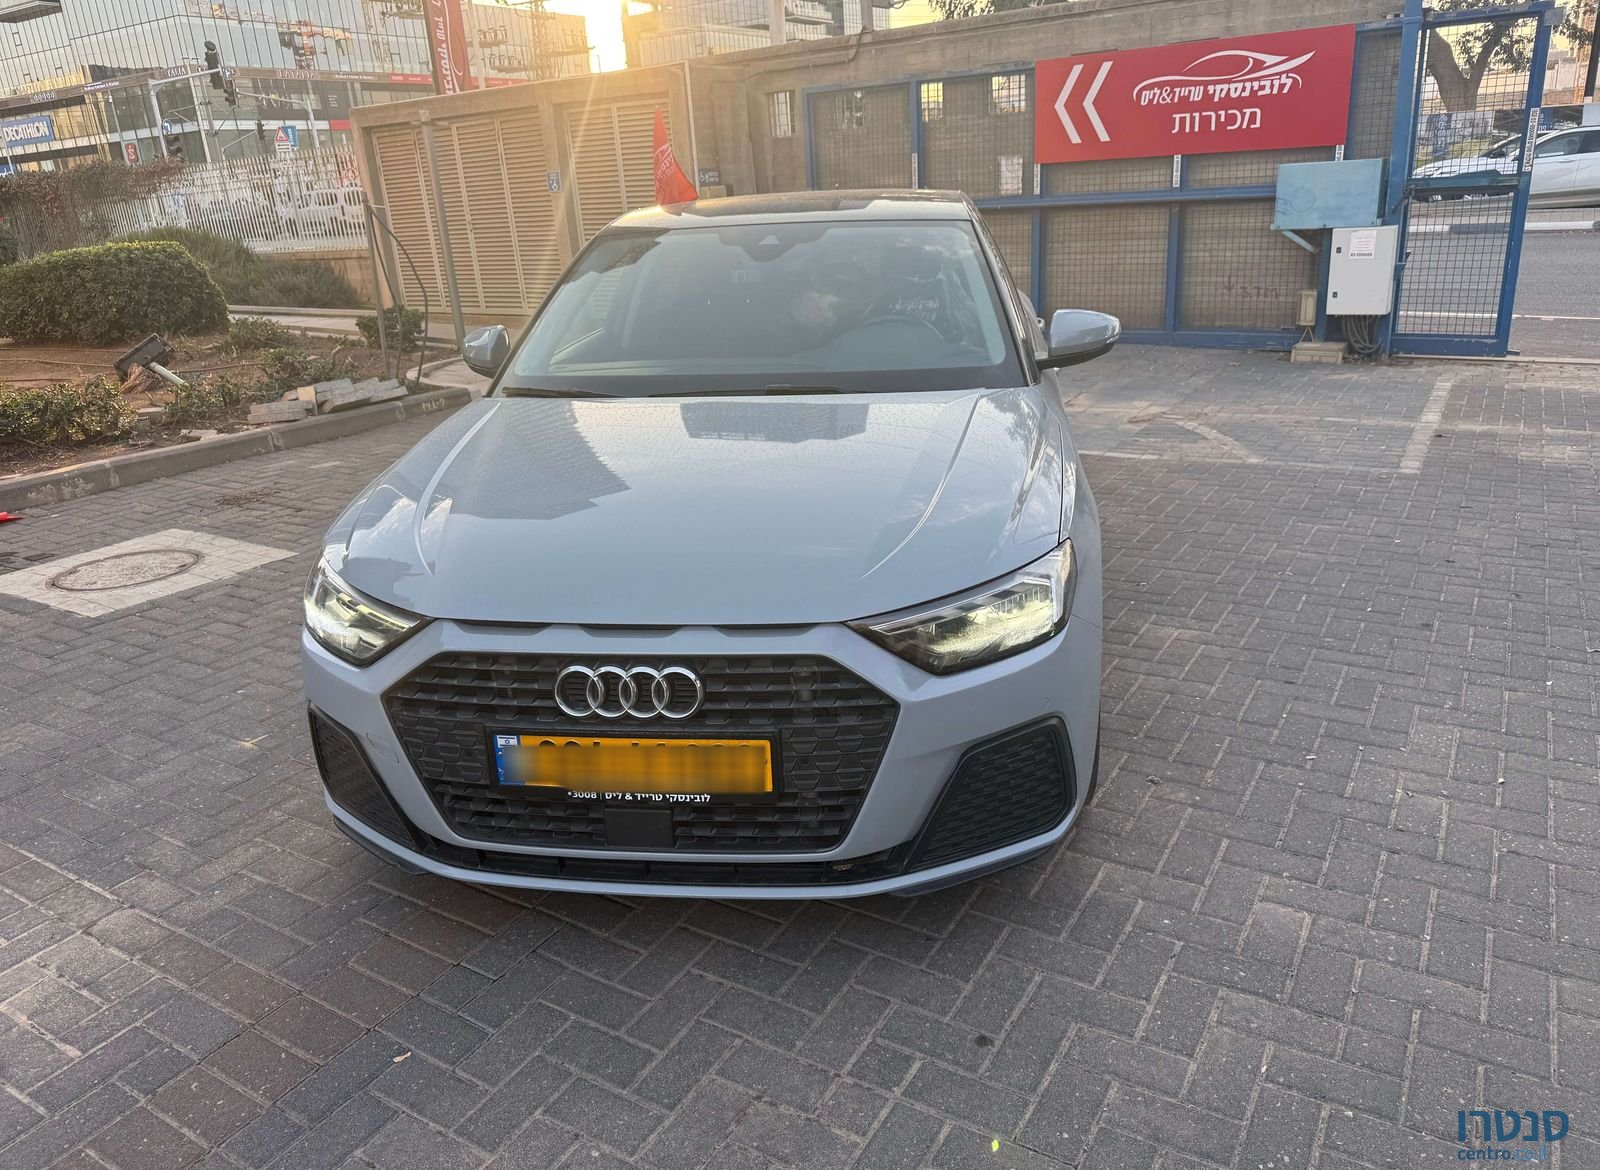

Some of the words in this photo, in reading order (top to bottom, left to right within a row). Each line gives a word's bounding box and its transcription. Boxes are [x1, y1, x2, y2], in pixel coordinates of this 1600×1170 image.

[1207, 73, 1294, 102] לובינסקי
[1171, 107, 1262, 134] מכירות
[3, 121, 50, 142] DECATHLON
[604, 790, 623, 801] ליס
[624, 792, 633, 801] &
[634, 792, 663, 802] טרייד
[665, 792, 711, 803] לובינסקי
